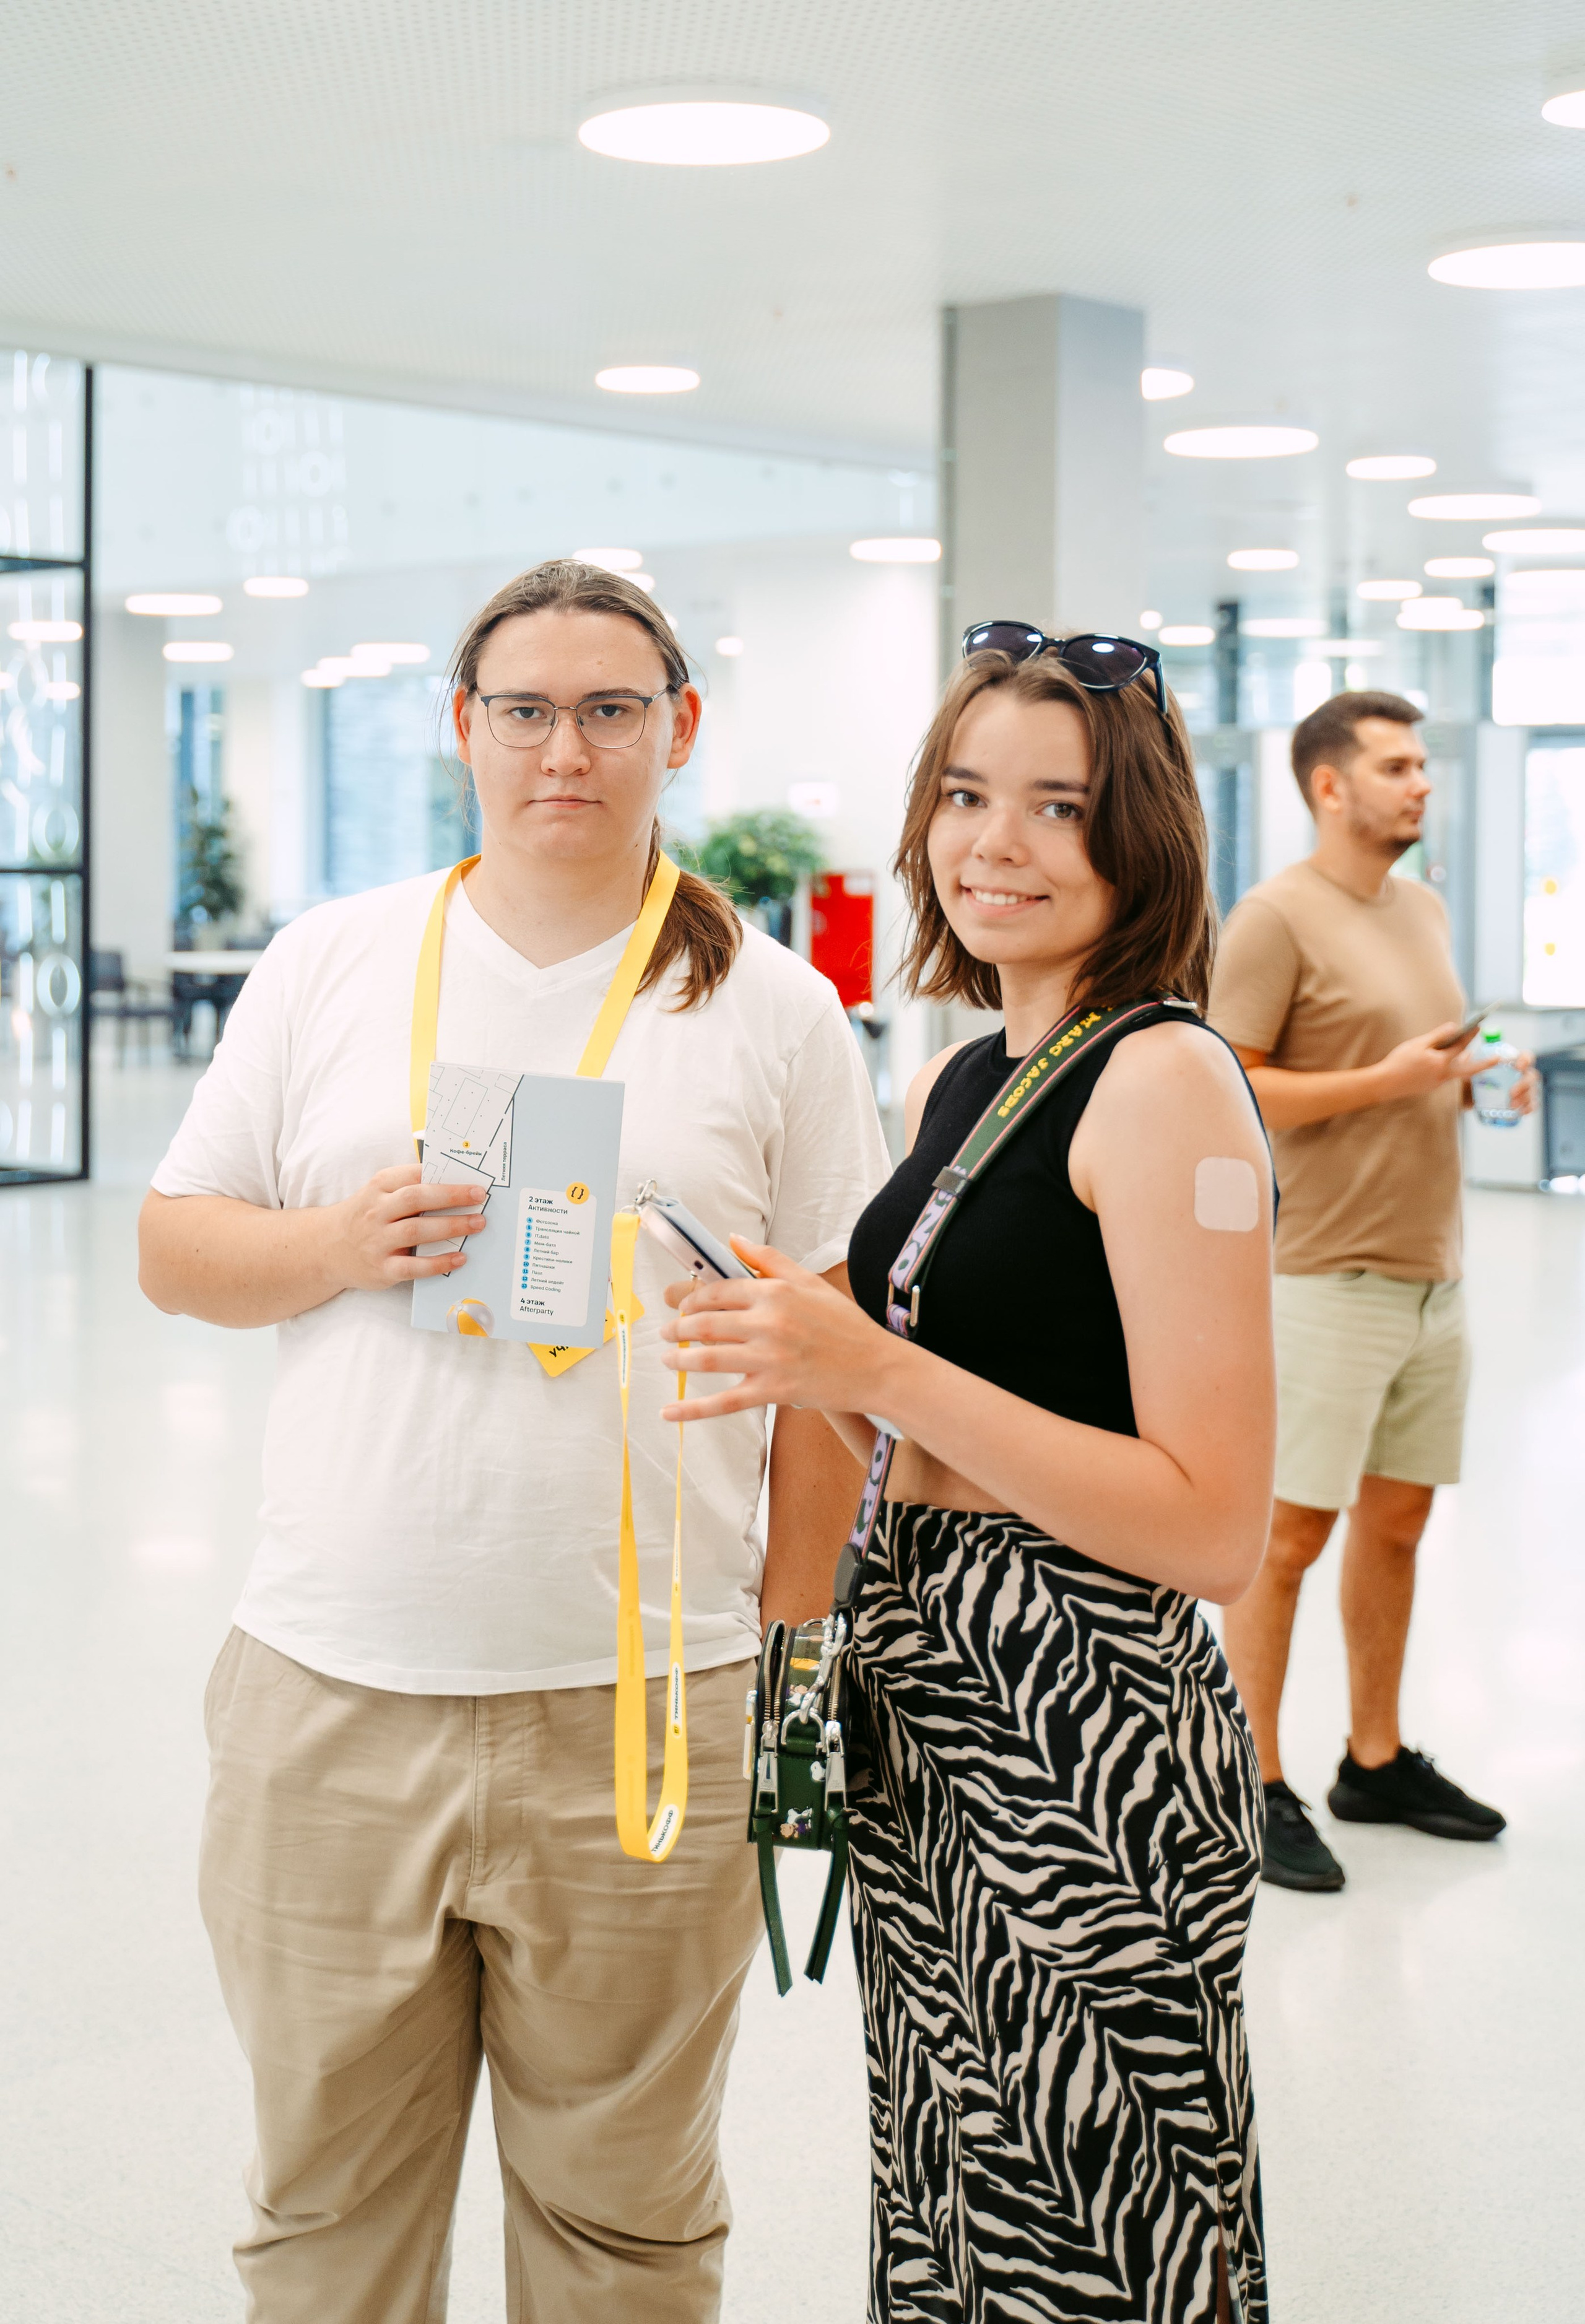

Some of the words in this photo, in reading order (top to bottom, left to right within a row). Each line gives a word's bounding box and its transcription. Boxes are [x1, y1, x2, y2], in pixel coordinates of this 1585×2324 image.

[1049, 1011, 1102, 1056] MARC
[997, 1057, 1049, 1118] JACOBS
[528, 1204, 568, 1214] Активности
[532, 1256, 573, 1264] Крестики-нолики
[519, 1305, 554, 1316] Afterparty
[651, 1809, 674, 1852] ТИНЬКОФФ
